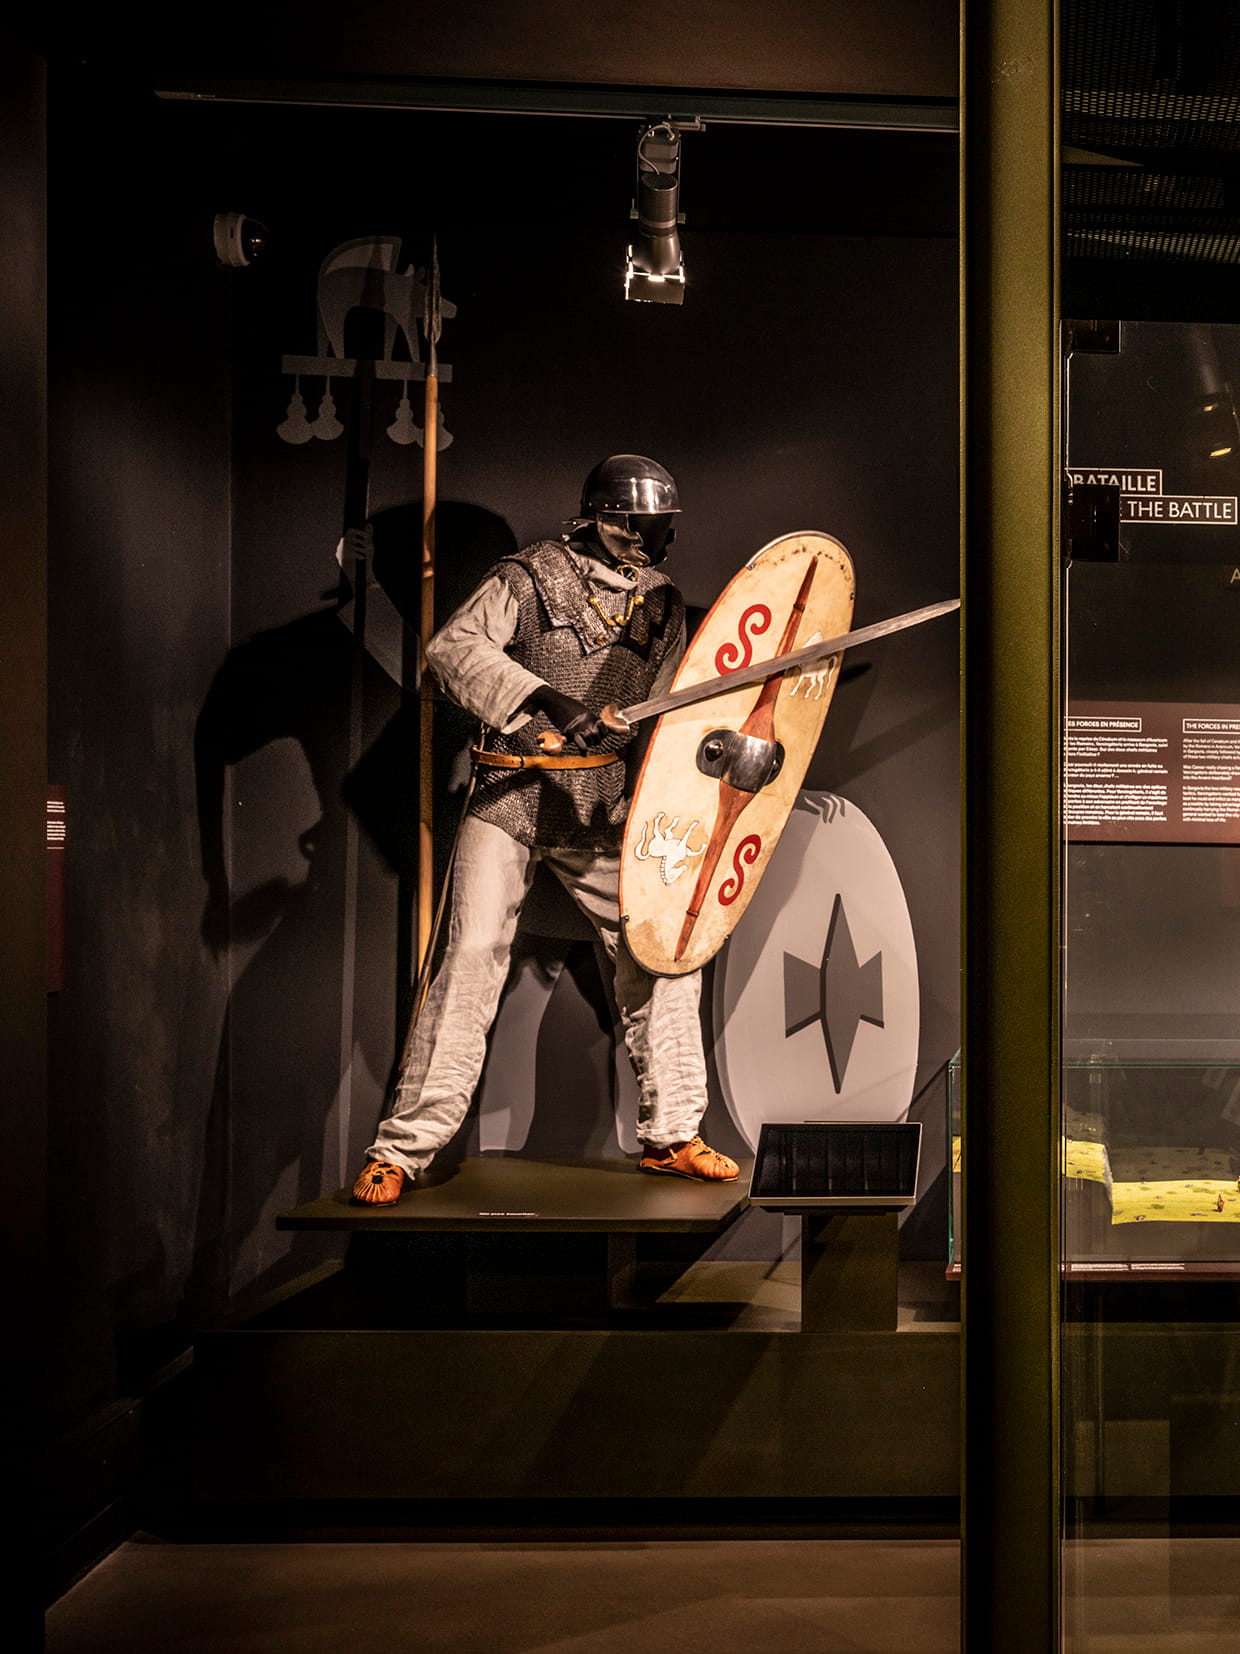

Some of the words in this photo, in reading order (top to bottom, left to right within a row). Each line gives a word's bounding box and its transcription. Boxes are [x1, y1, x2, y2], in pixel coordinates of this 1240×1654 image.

[1127, 501, 1163, 518] THE
[1169, 502, 1232, 519] BATTLE
[1101, 721, 1110, 729] EN
[1186, 722, 1197, 730] THE
[1198, 722, 1221, 731] FORCES
